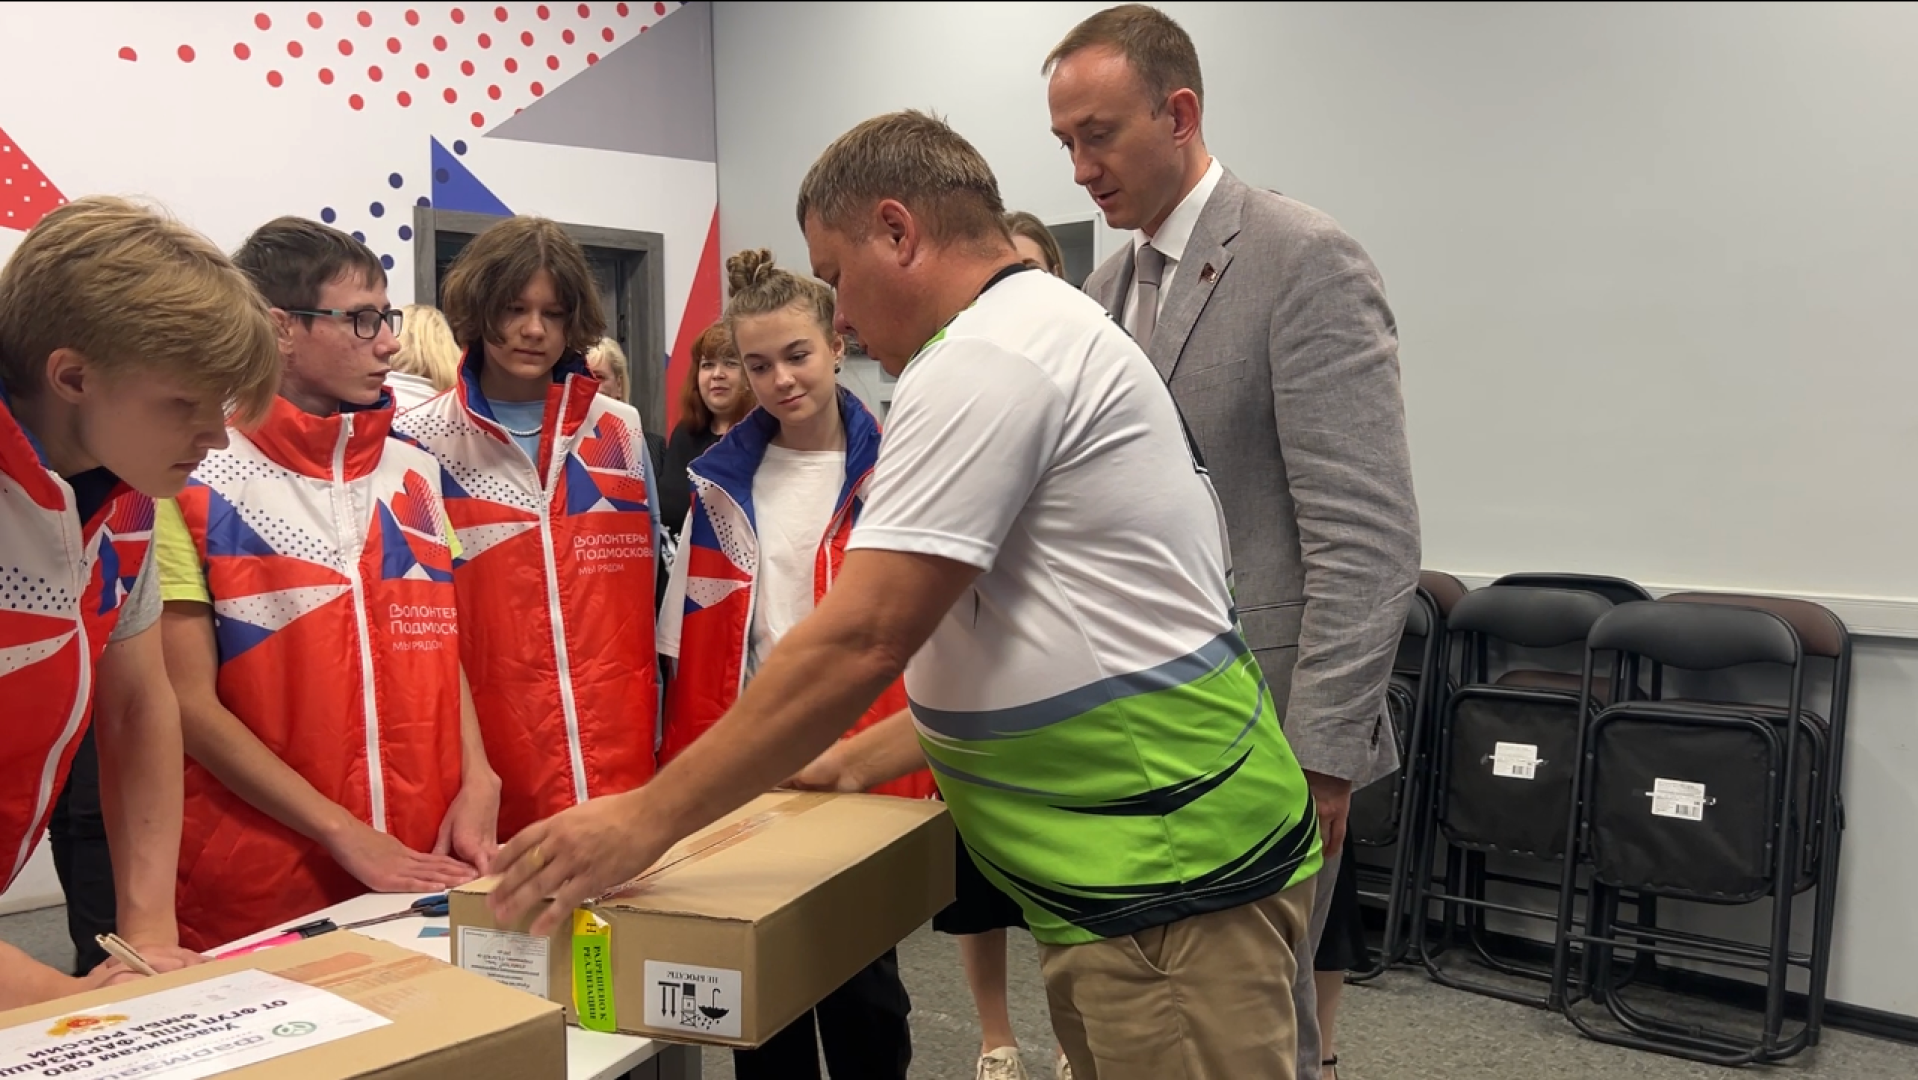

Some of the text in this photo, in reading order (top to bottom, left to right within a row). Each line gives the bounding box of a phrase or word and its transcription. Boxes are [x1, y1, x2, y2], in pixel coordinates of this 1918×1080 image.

[389, 603, 458, 619] ВОЛОНТЕР
[390, 619, 458, 635] ПОДМОСК
[593, 945, 608, 1021] РАЗРЕШЕНО К
[708, 975, 719, 984] НЕ
[129, 1013, 198, 1032] ФМБА
[199, 1006, 258, 1026] ФГУП
[143, 1022, 199, 1038] НПЦ
[26, 1030, 128, 1059] РОССИИ
[97, 1021, 241, 1061] Участникам
[42, 1058, 95, 1078] СВО
